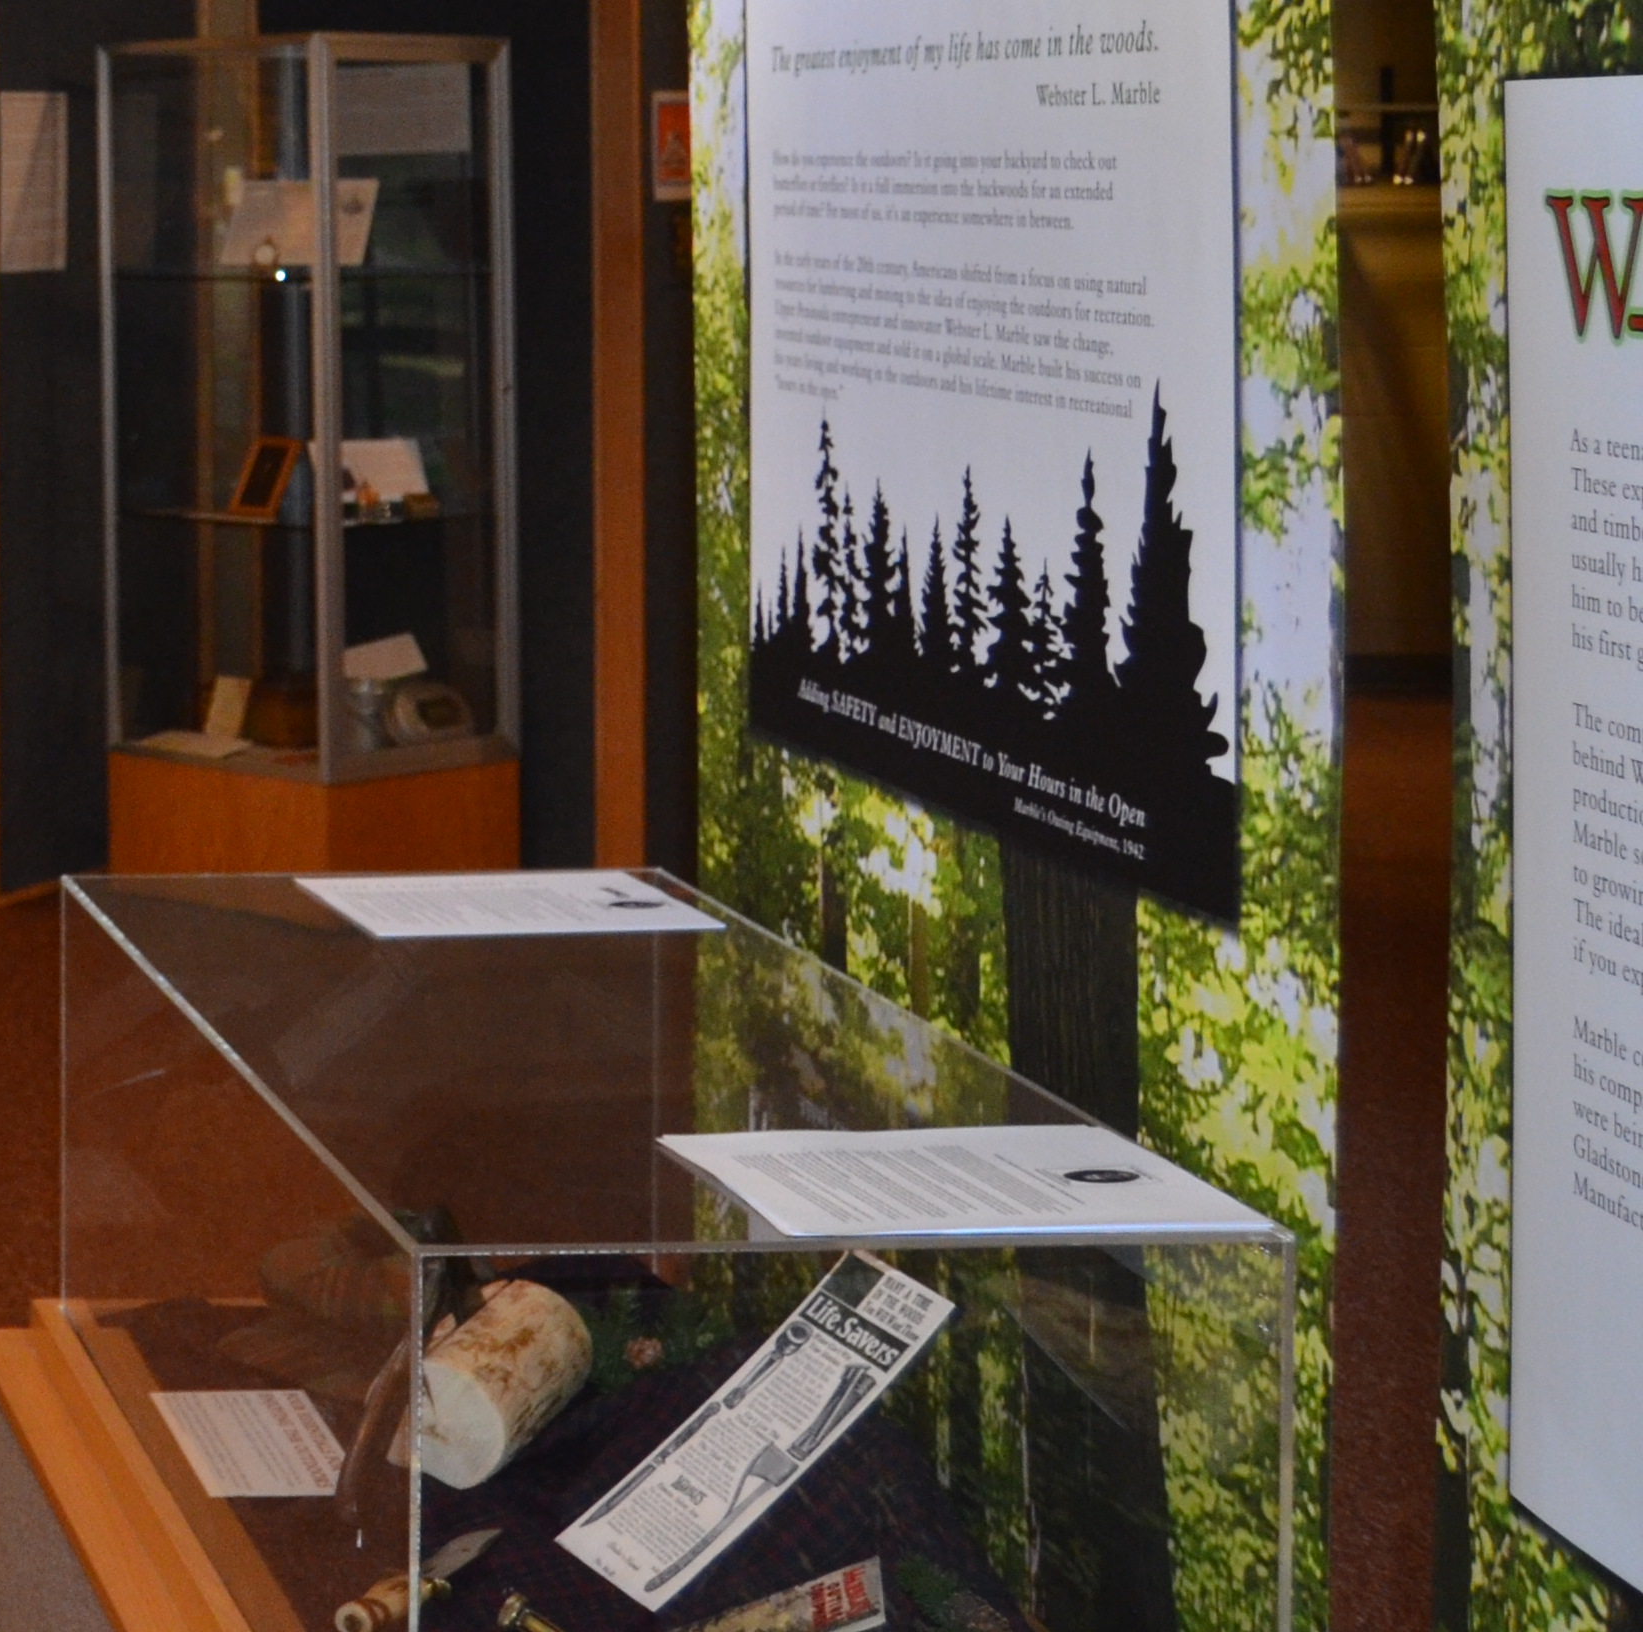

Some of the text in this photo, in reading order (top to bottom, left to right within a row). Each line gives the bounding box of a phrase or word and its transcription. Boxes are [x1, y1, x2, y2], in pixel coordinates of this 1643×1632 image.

[838, 40, 902, 74] enjoyment
[905, 34, 922, 71] of
[923, 41, 944, 70] my
[947, 31, 972, 69] life
[976, 29, 1000, 61] has
[1004, 35, 1041, 60] come
[1047, 26, 1063, 57] in
[1068, 23, 1094, 56] the
[1099, 19, 1160, 54] woods.
[1035, 80, 1162, 107] Webster L. Marble
[1050, 154, 1061, 169] to
[1063, 149, 1094, 170] check
[1097, 154, 1117, 170] out
[1032, 178, 1046, 198] for
[1049, 185, 1061, 199] an
[1064, 180, 1113, 201] extended
[1029, 208, 1075, 230] between.
[1028, 267, 1054, 288] focus
[1057, 276, 1071, 290] on
[1074, 271, 1104, 298] using
[1106, 275, 1147, 296] natural
[1027, 298, 1072, 321] outdoors
[1075, 300, 1091, 322] for
[1094, 306, 1155, 328] recreation.
[1033, 332, 1051, 347] saw
[1053, 328, 1070, 350] the
[1065, 360, 1081, 381] his
[1083, 368, 1123, 387] success
[1126, 374, 1142, 389] on
[1015, 385, 1053, 407] interest
[1055, 389, 1066, 408] in
[1069, 395, 1133, 419] recreational
[1570, 427, 1643, 461] As a teen
[1570, 466, 1643, 510] These ex
[1571, 508, 1643, 543] and timb
[1571, 551, 1643, 586] usually h
[1571, 583, 1601, 614] him
[1607, 598, 1622, 619] to
[1571, 622, 1632, 662] his first
[1572, 701, 1602, 733] The
[797, 677, 1146, 828] Adding SAFETY and ENJOYMENT to Your Hours in the Open
[1572, 739, 1625, 780] behind
[1047, 809, 1076, 836] Outing
[1122, 838, 1146, 860] 1942
[1572, 818, 1627, 861] Marble
[1573, 864, 1588, 886] to
[1572, 897, 1603, 932] The
[1573, 936, 1586, 964] if
[1588, 949, 1616, 978] you
[1573, 1015, 1643, 1068] Marble c
[1573, 1053, 1595, 1086] his
[1572, 1099, 1608, 1132] were
[1573, 1133, 1643, 1190] Gladston
[804, 1294, 842, 1333] Life
[836, 1316, 900, 1366] Savers
